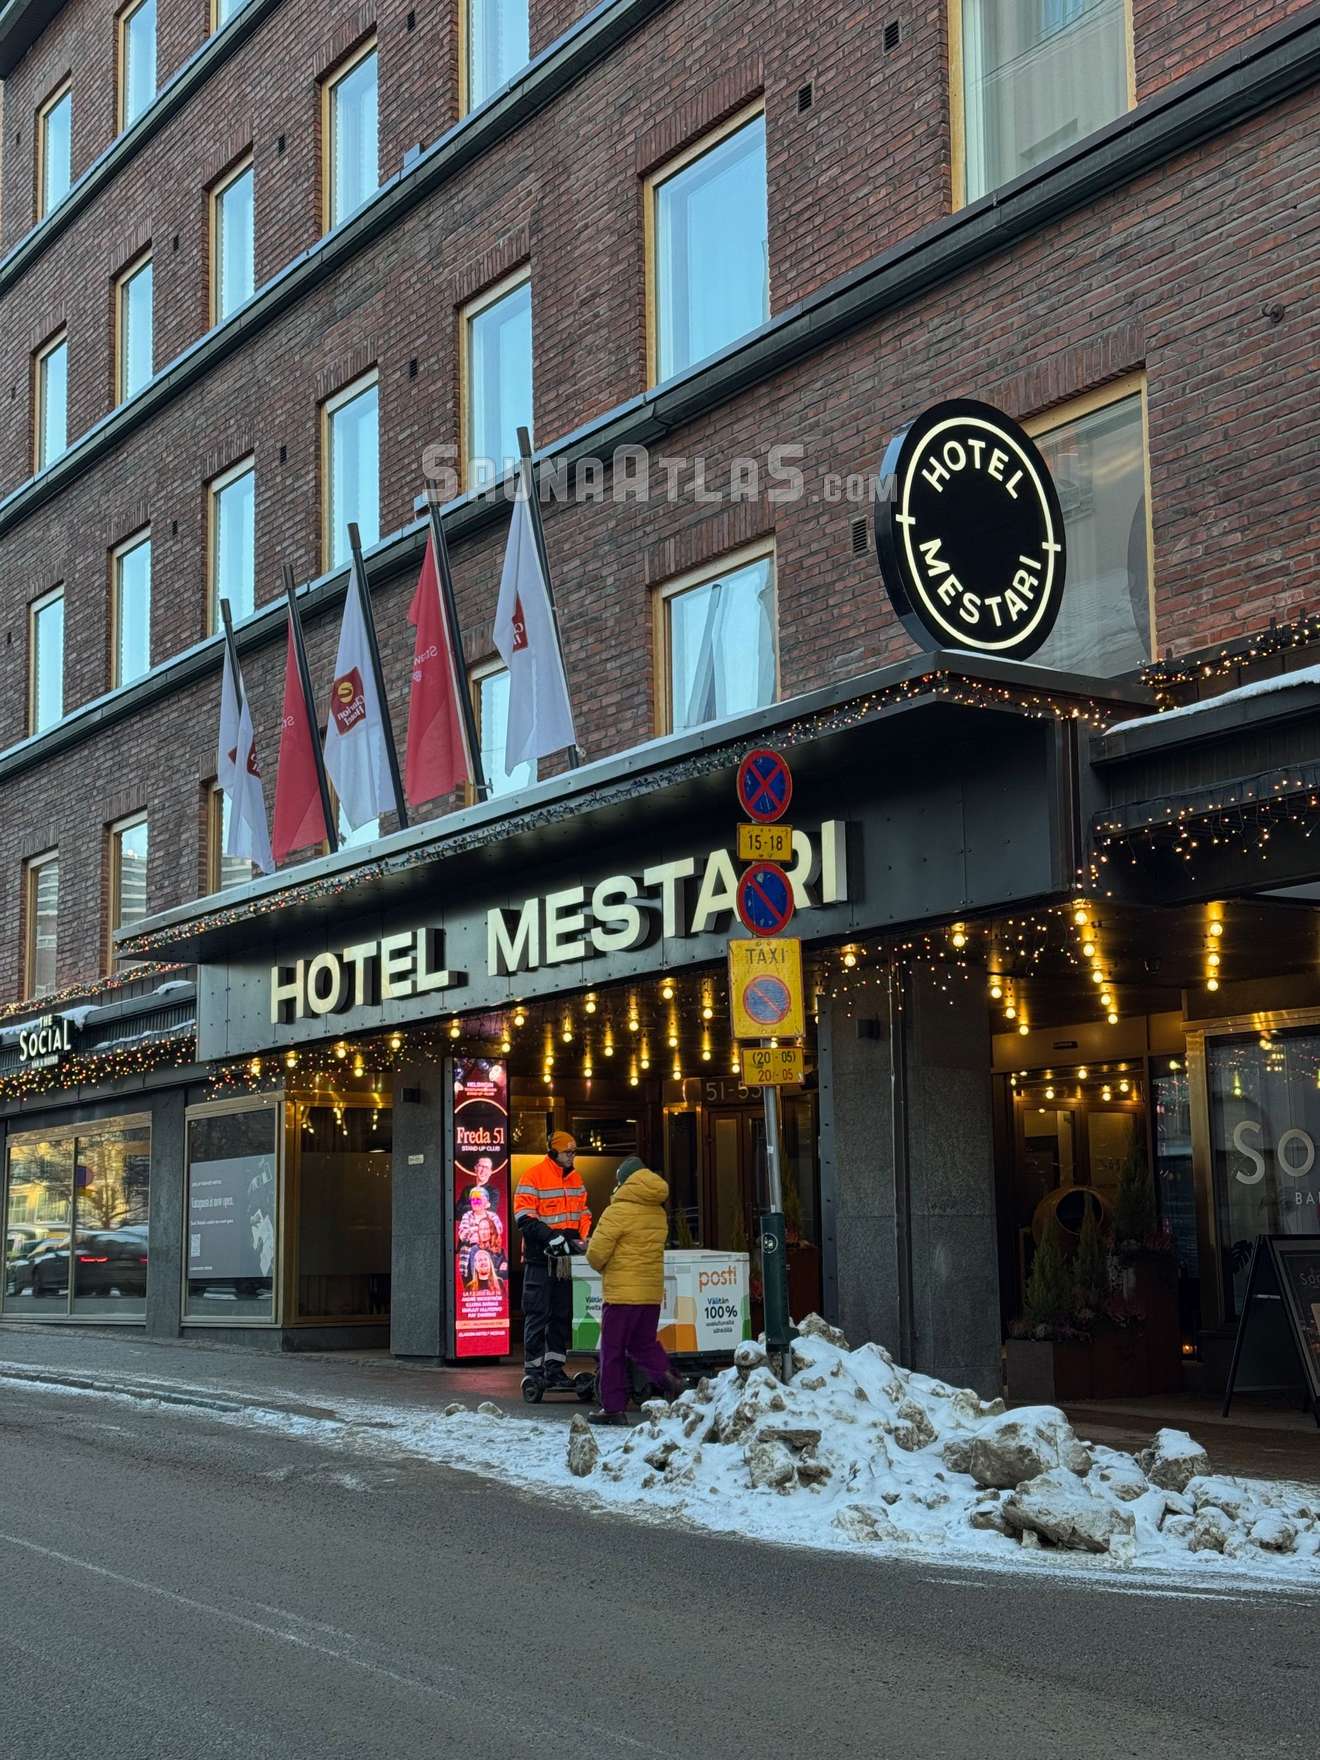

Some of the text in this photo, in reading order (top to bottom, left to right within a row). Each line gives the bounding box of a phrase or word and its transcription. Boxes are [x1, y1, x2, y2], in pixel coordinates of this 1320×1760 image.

[921, 438, 1024, 499] HOTEL
[919, 538, 1042, 627] MESTARI
[270, 819, 848, 1024] HOTEL MESTARI
[745, 948, 788, 964] TAXI
[40, 1014, 53, 1029] THE
[20, 1019, 72, 1061] SOCIAL
[456, 1127, 505, 1144] Freda 51
[698, 1265, 737, 1293] posti
[705, 1305, 738, 1319] 100%
